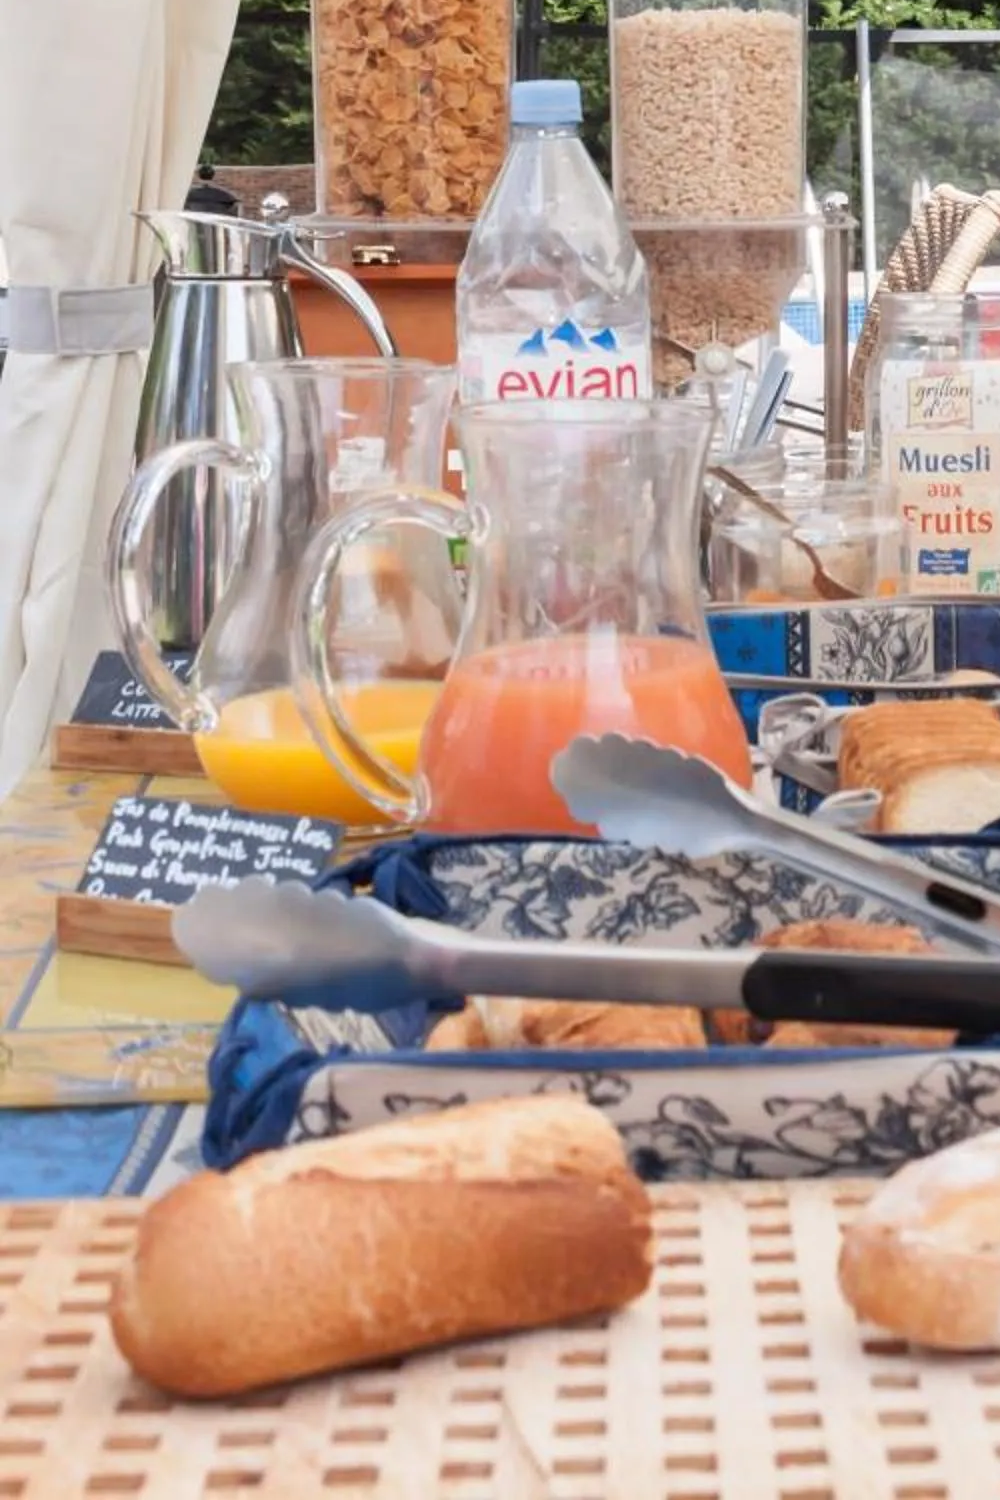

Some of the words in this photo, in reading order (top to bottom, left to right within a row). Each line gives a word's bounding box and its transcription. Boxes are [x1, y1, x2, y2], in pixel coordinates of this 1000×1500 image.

[497, 360, 638, 399] evian
[899, 446, 990, 474] Muesli
[928, 483, 964, 498] aux
[253, 844, 318, 877] Juice
